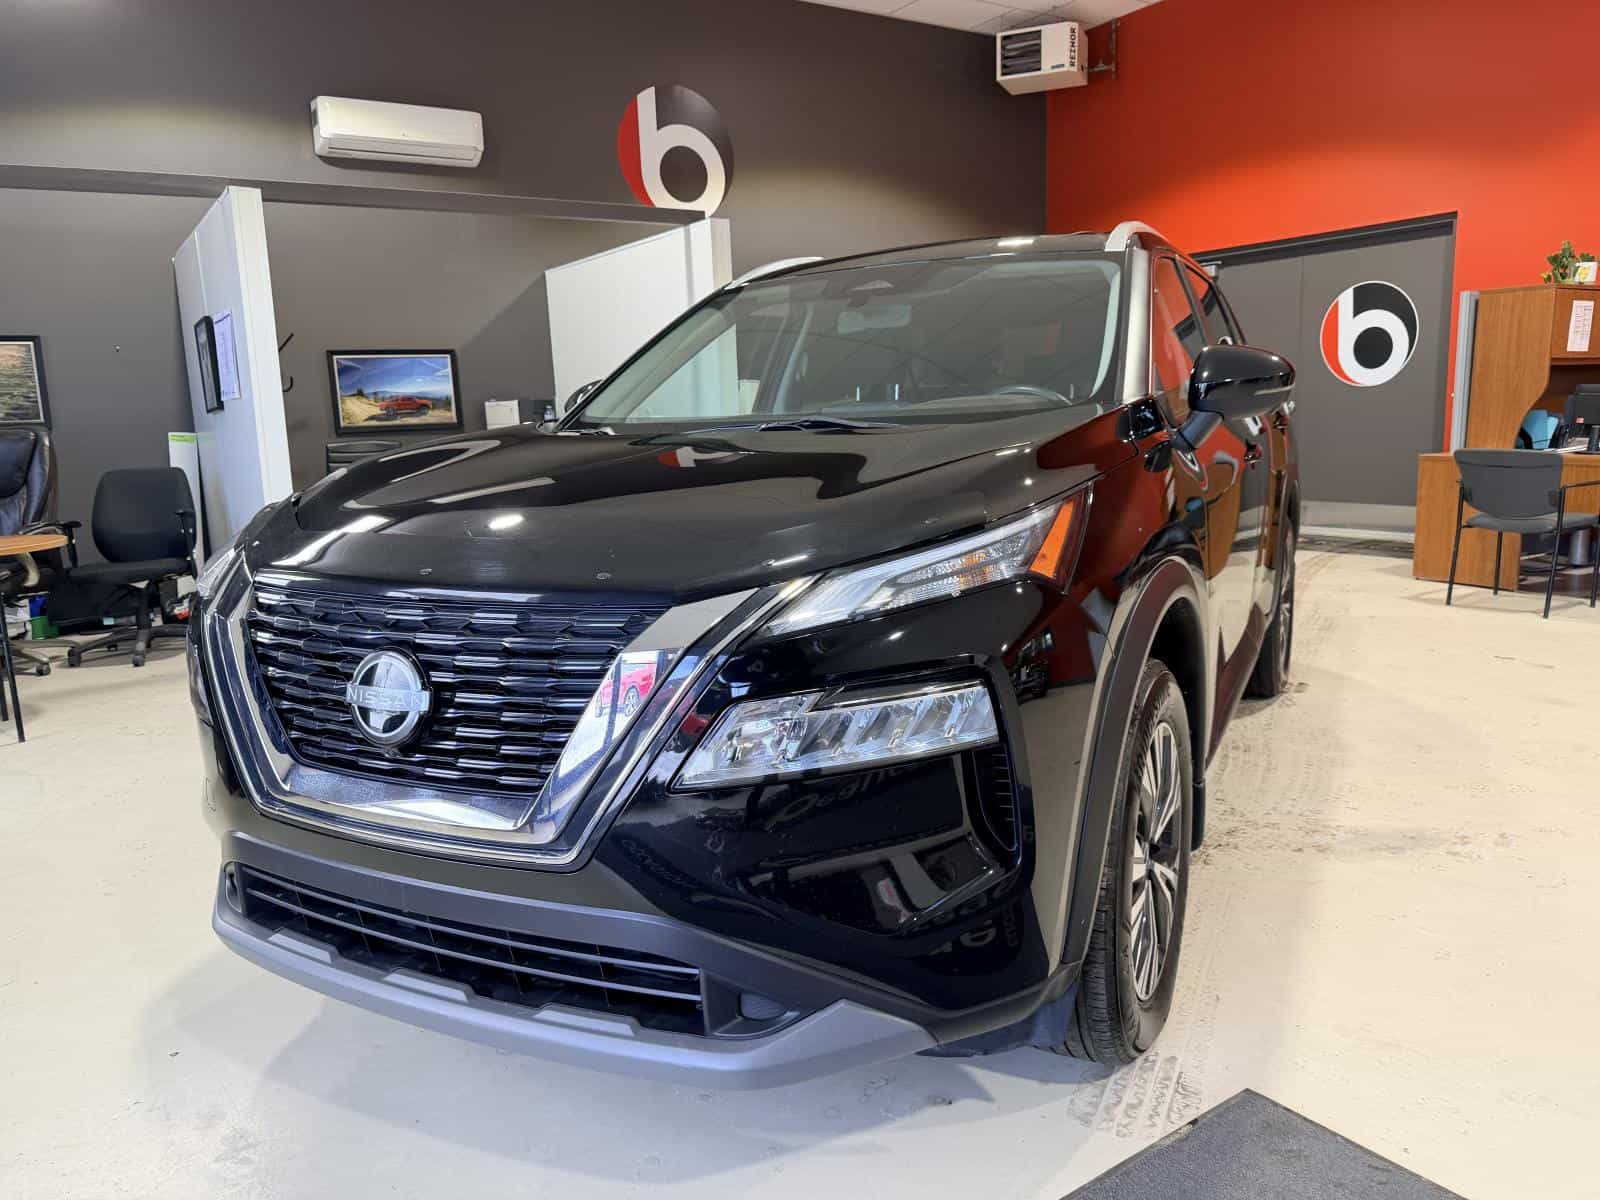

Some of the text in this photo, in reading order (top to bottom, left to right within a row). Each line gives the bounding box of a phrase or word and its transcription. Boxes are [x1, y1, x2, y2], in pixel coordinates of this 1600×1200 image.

[1069, 24, 1077, 67] REZNOR
[1338, 286, 1410, 386] b
[346, 686, 427, 707] NISSAN
